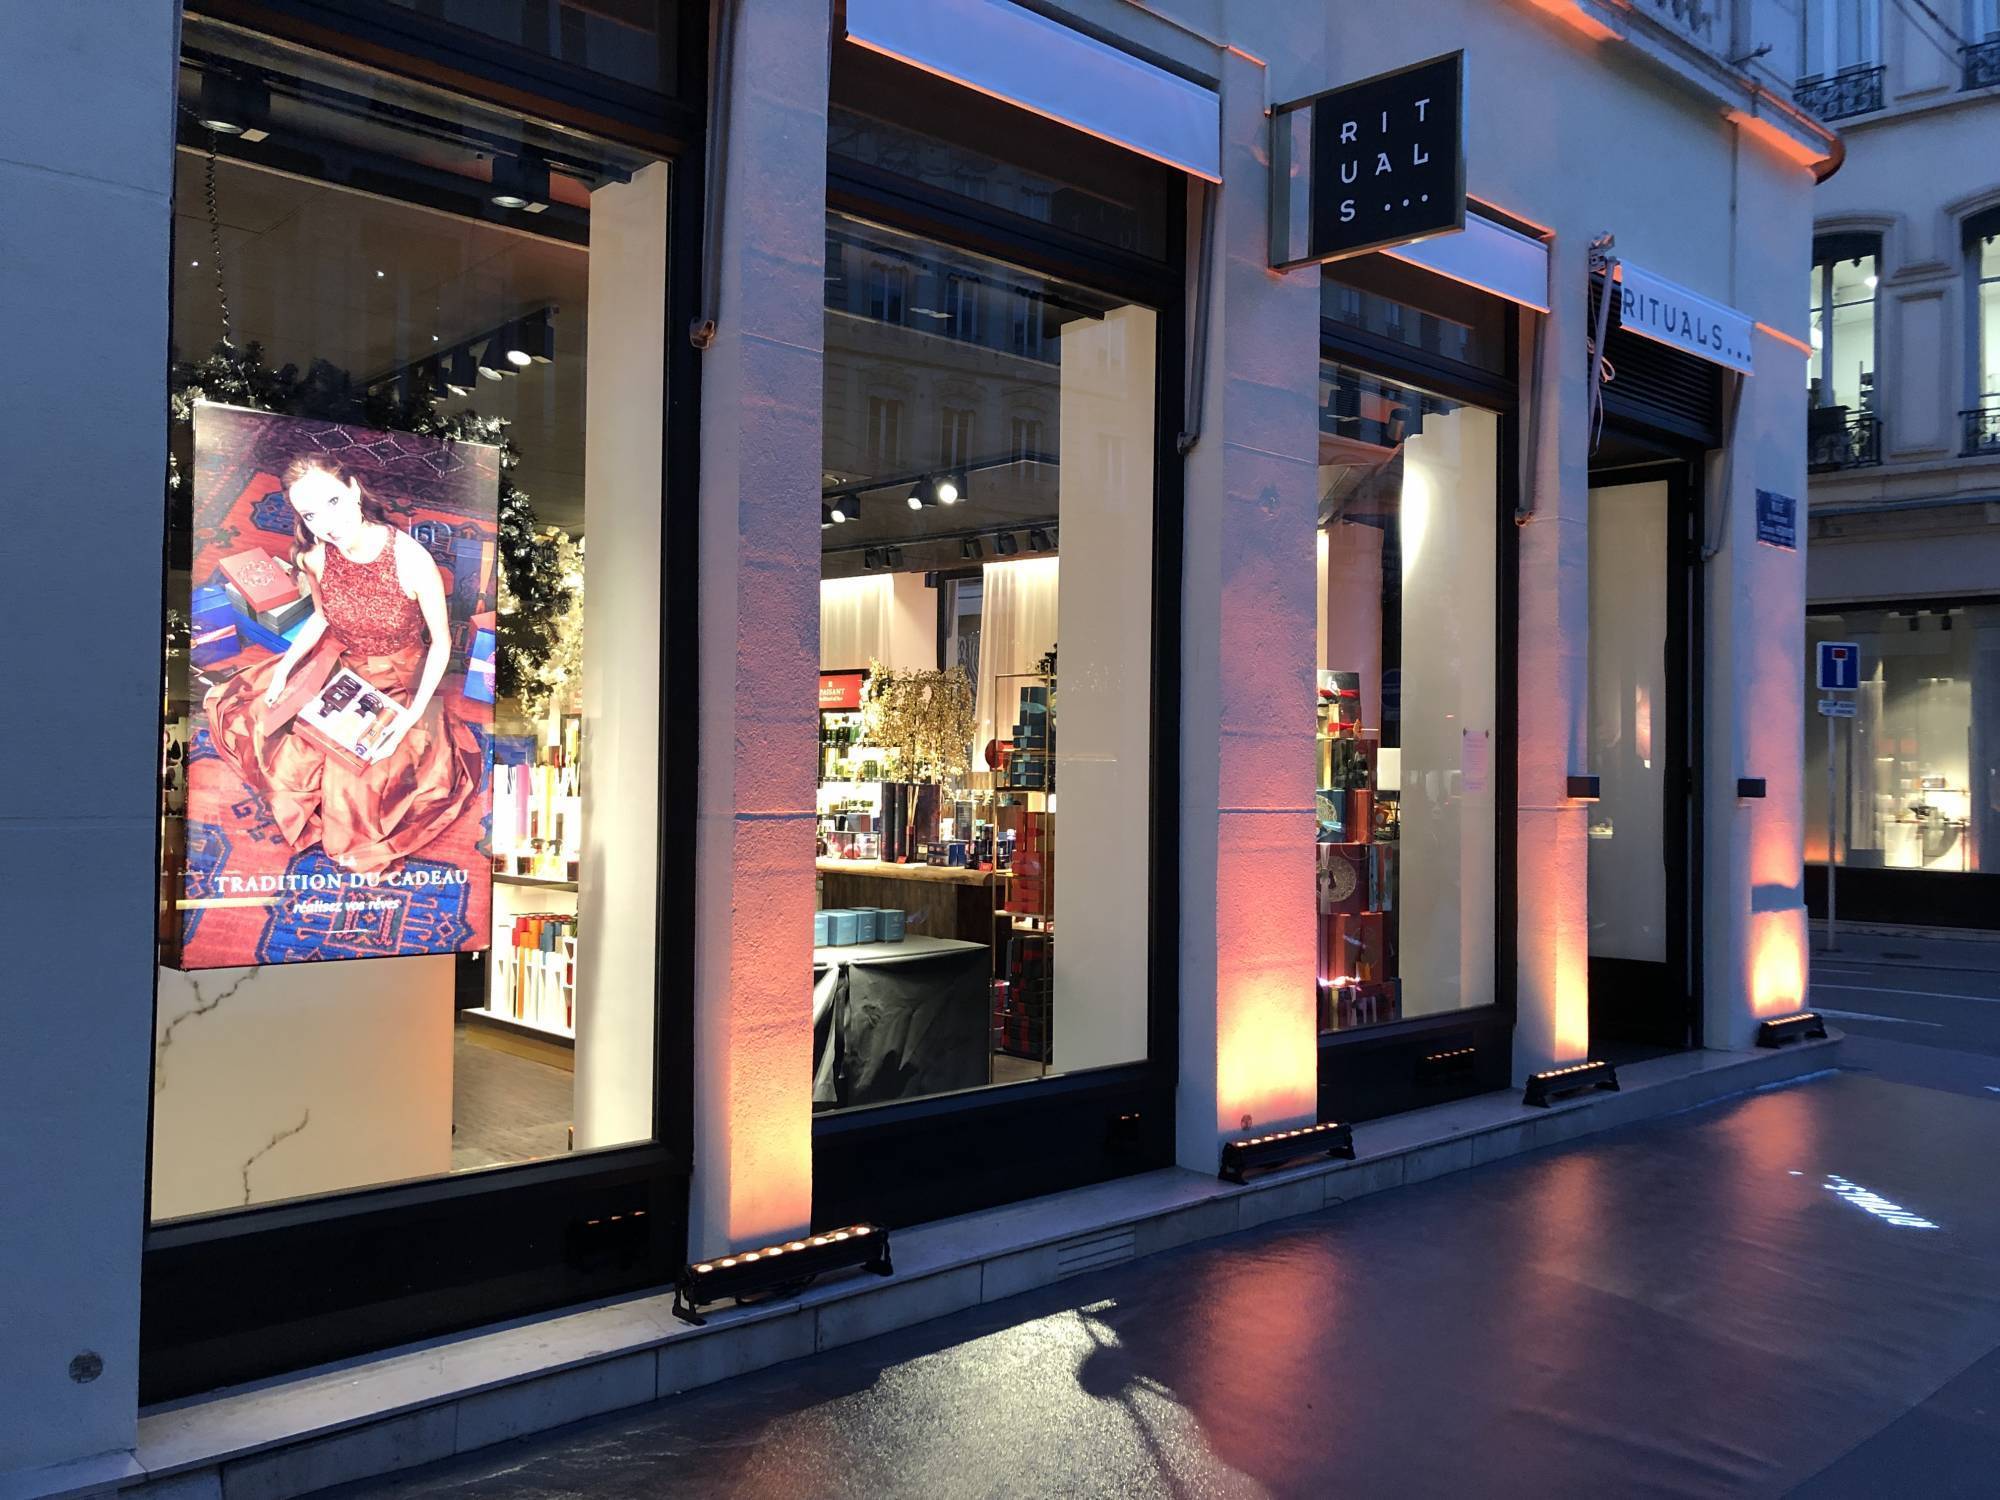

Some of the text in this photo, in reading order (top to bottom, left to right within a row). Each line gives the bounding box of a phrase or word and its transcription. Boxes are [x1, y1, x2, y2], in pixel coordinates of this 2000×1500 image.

[1623, 287, 1751, 362] RITUALS...
[339, 856, 357, 867] LA
[214, 869, 469, 893] TRADITION DU CADEAU
[345, 901, 366, 911] vos
[368, 897, 399, 910] rêves
